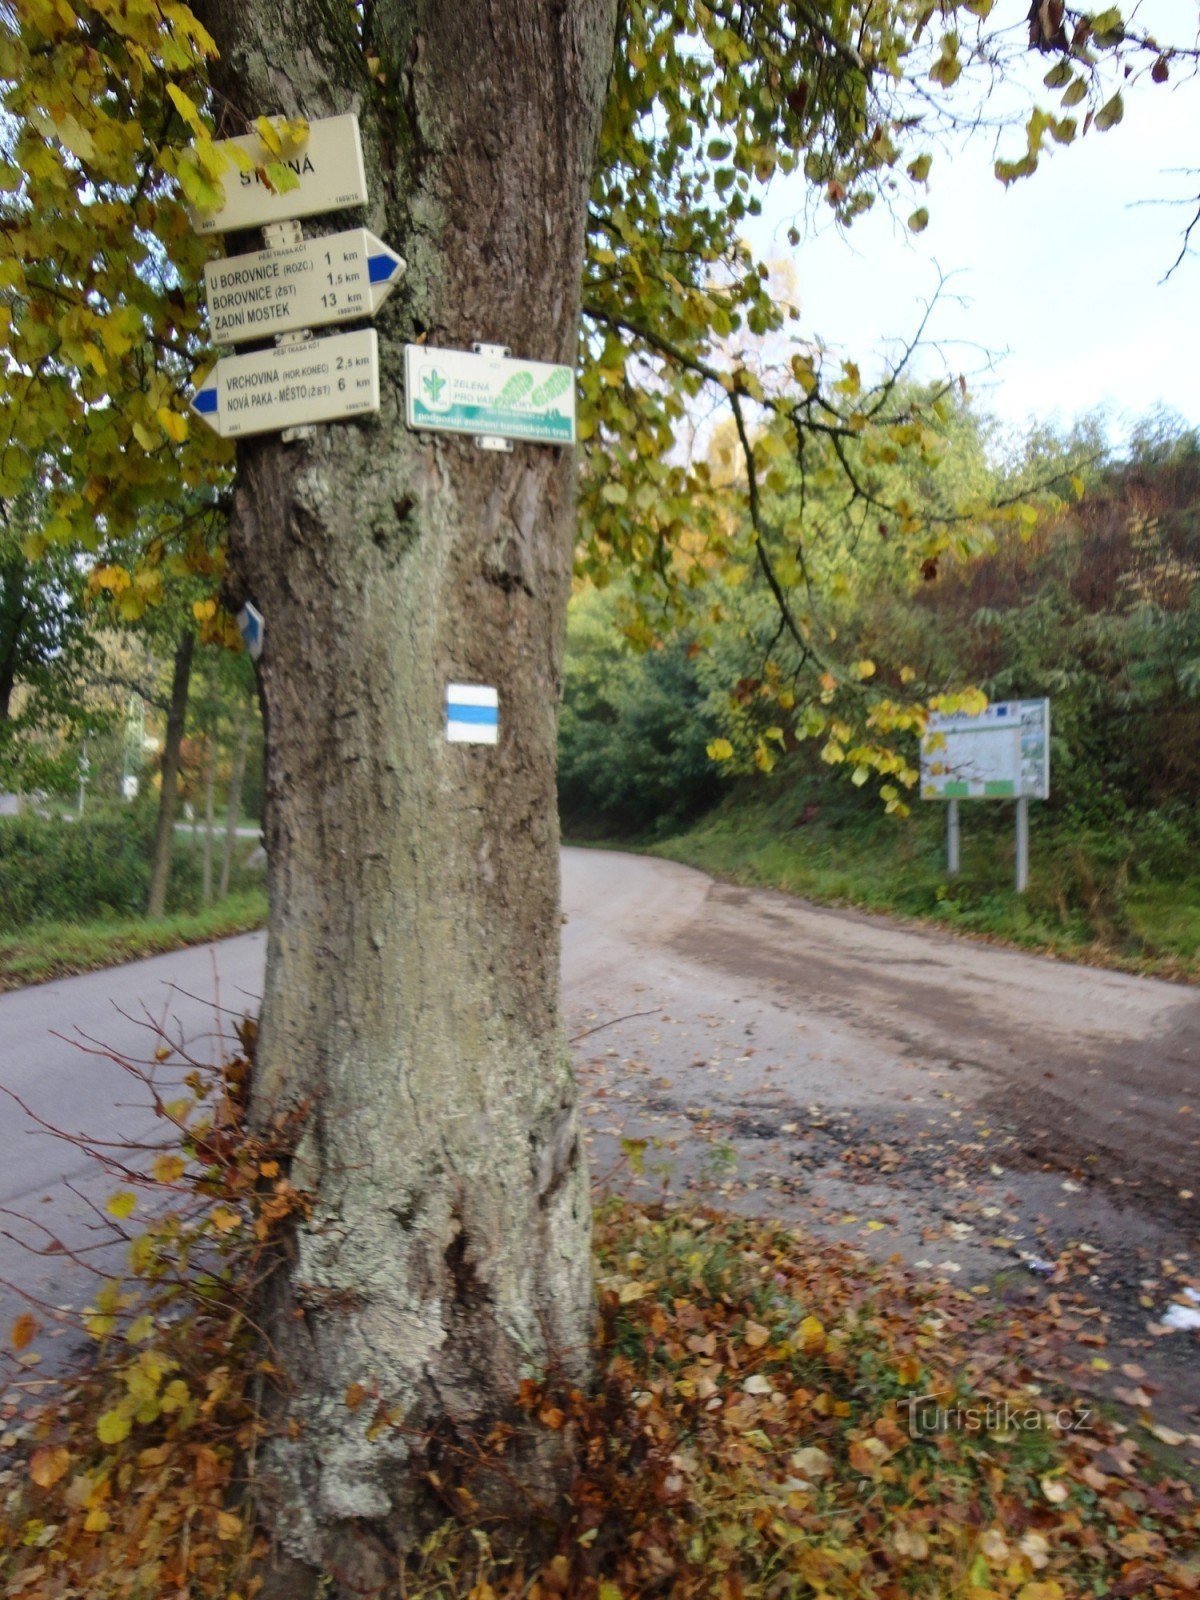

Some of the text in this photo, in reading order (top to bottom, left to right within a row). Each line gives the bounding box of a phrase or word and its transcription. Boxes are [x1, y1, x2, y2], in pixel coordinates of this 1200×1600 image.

[210, 251, 358, 290] U BOROVNICE (ROZC.) 1 km
[213, 272, 360, 310] BOROVNICE (ŽST) 1,5 km
[215, 292, 362, 330] ZADNÍ MOSTEK 13 km
[226, 369, 279, 391] VRCHOVINA
[335, 356, 353, 370] 2,5
[355, 356, 370, 366] km
[227, 393, 250, 411] NOVÁ
[251, 391, 273, 407] PAKA
[338, 377, 346, 391] 6
[356, 377, 370, 388] km
